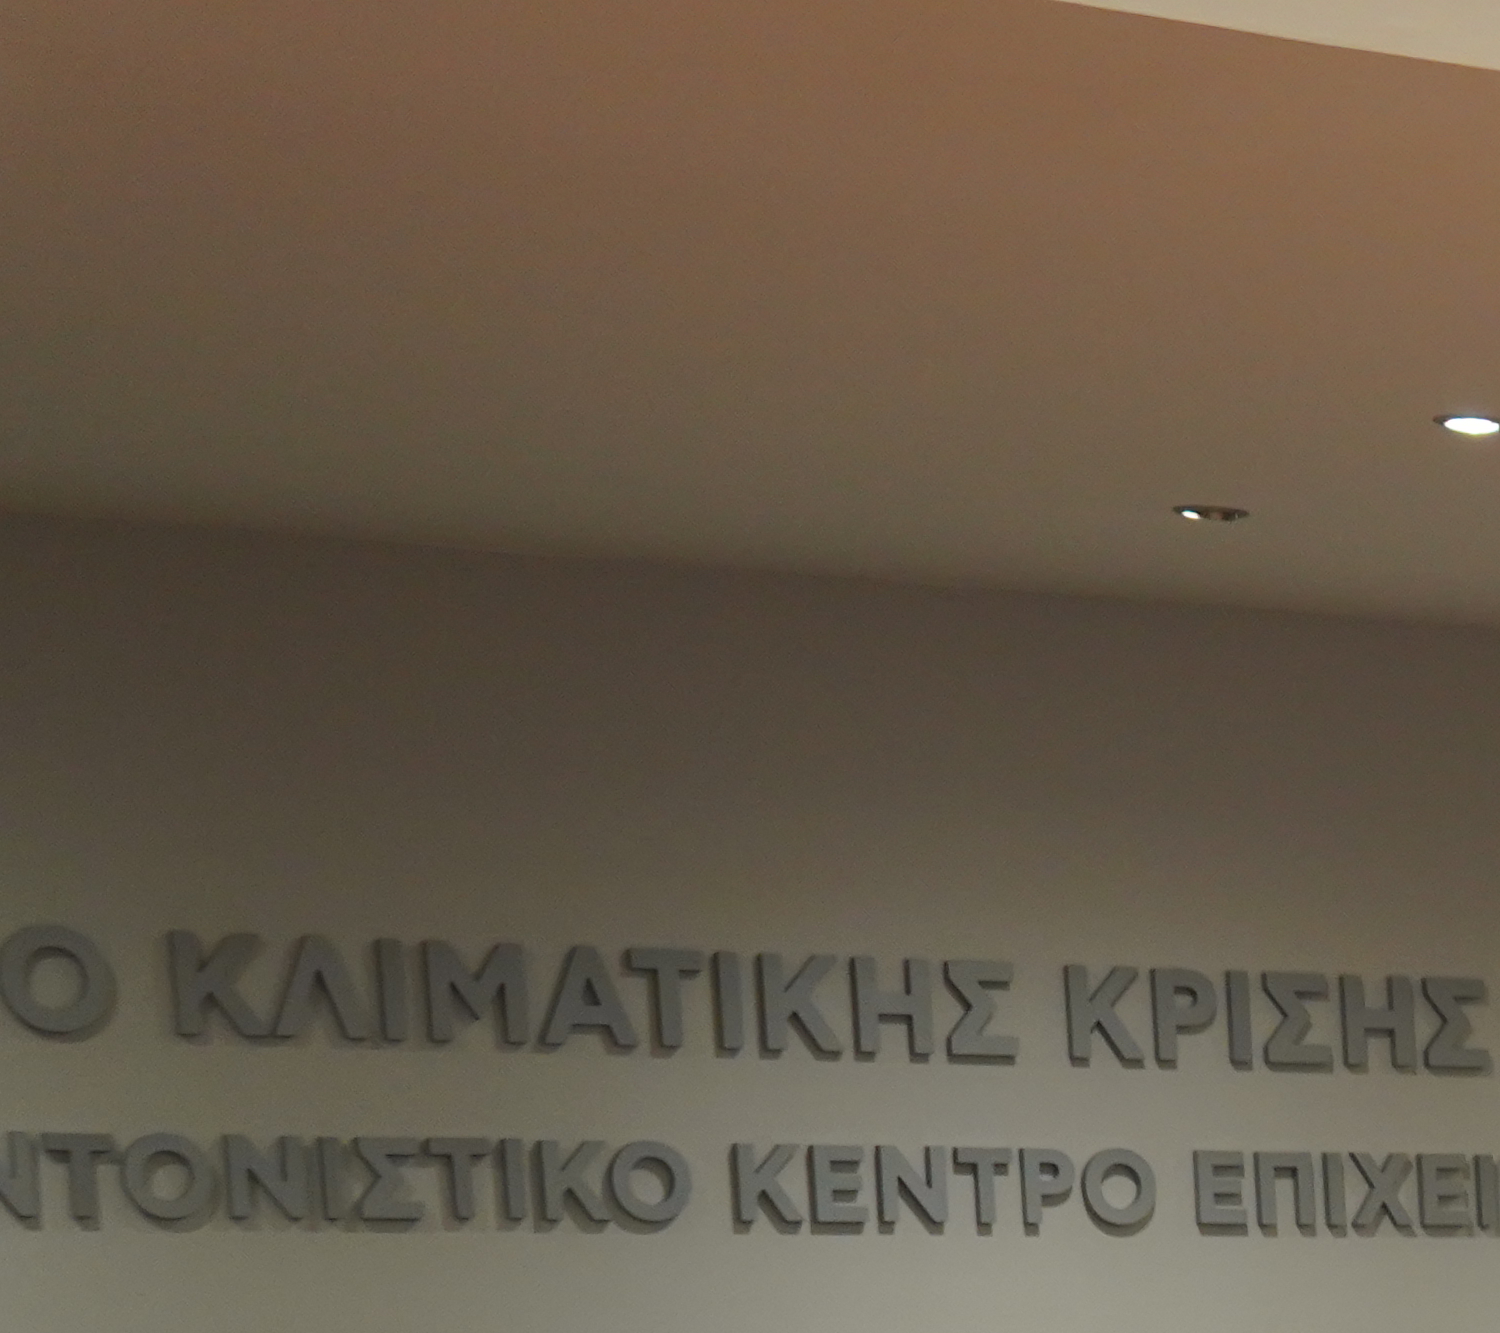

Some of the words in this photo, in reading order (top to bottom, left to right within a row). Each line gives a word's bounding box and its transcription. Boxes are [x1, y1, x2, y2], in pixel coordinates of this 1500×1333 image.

[164, 928, 1018, 1065] ΚΛΙΜΑΤΙΚΗΣ
[1063, 964, 1494, 1077] ΚΡΙΣΗΣ
[728, 1142, 1157, 1236] ΚΕΝΤΡΟ
